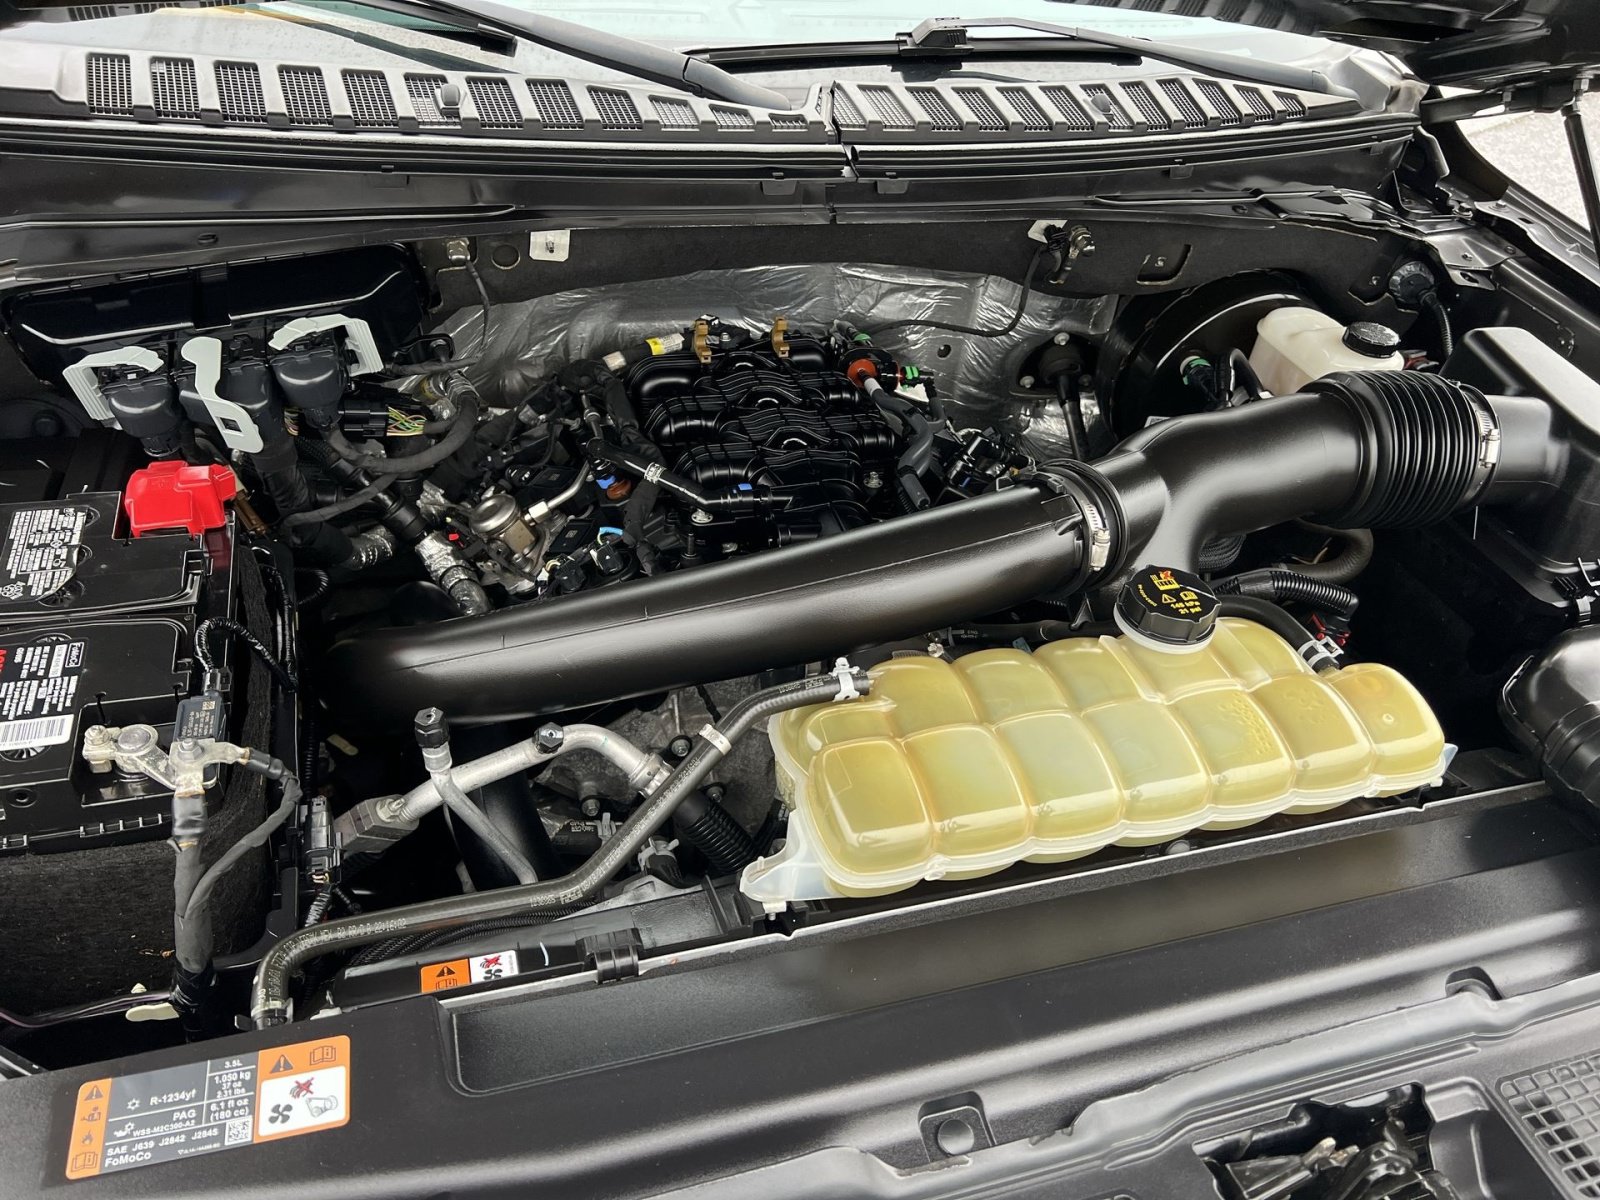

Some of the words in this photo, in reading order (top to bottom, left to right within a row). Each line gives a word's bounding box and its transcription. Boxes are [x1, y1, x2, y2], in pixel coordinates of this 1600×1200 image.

[69, 643, 82, 667] FoMoCo
[224, 1059, 243, 1069] 3.5L
[214, 1072, 238, 1085] 1.050
[239, 1070, 251, 1080] kg
[221, 1082, 231, 1090] 37
[149, 1089, 196, 1105] R-1234yf
[210, 1101, 225, 1112] 6.1
[227, 1099, 235, 1109] fl
[236, 1098, 249, 1107] oz
[173, 1109, 197, 1121] PAG
[210, 1109, 231, 1123] (180
[233, 1106, 250, 1117] cc)
[106, 1145, 128, 1157] SAE
[132, 1140, 155, 1152] J639
[158, 1134, 186, 1147] J2842
[104, 1151, 152, 1168] FoMoCo
